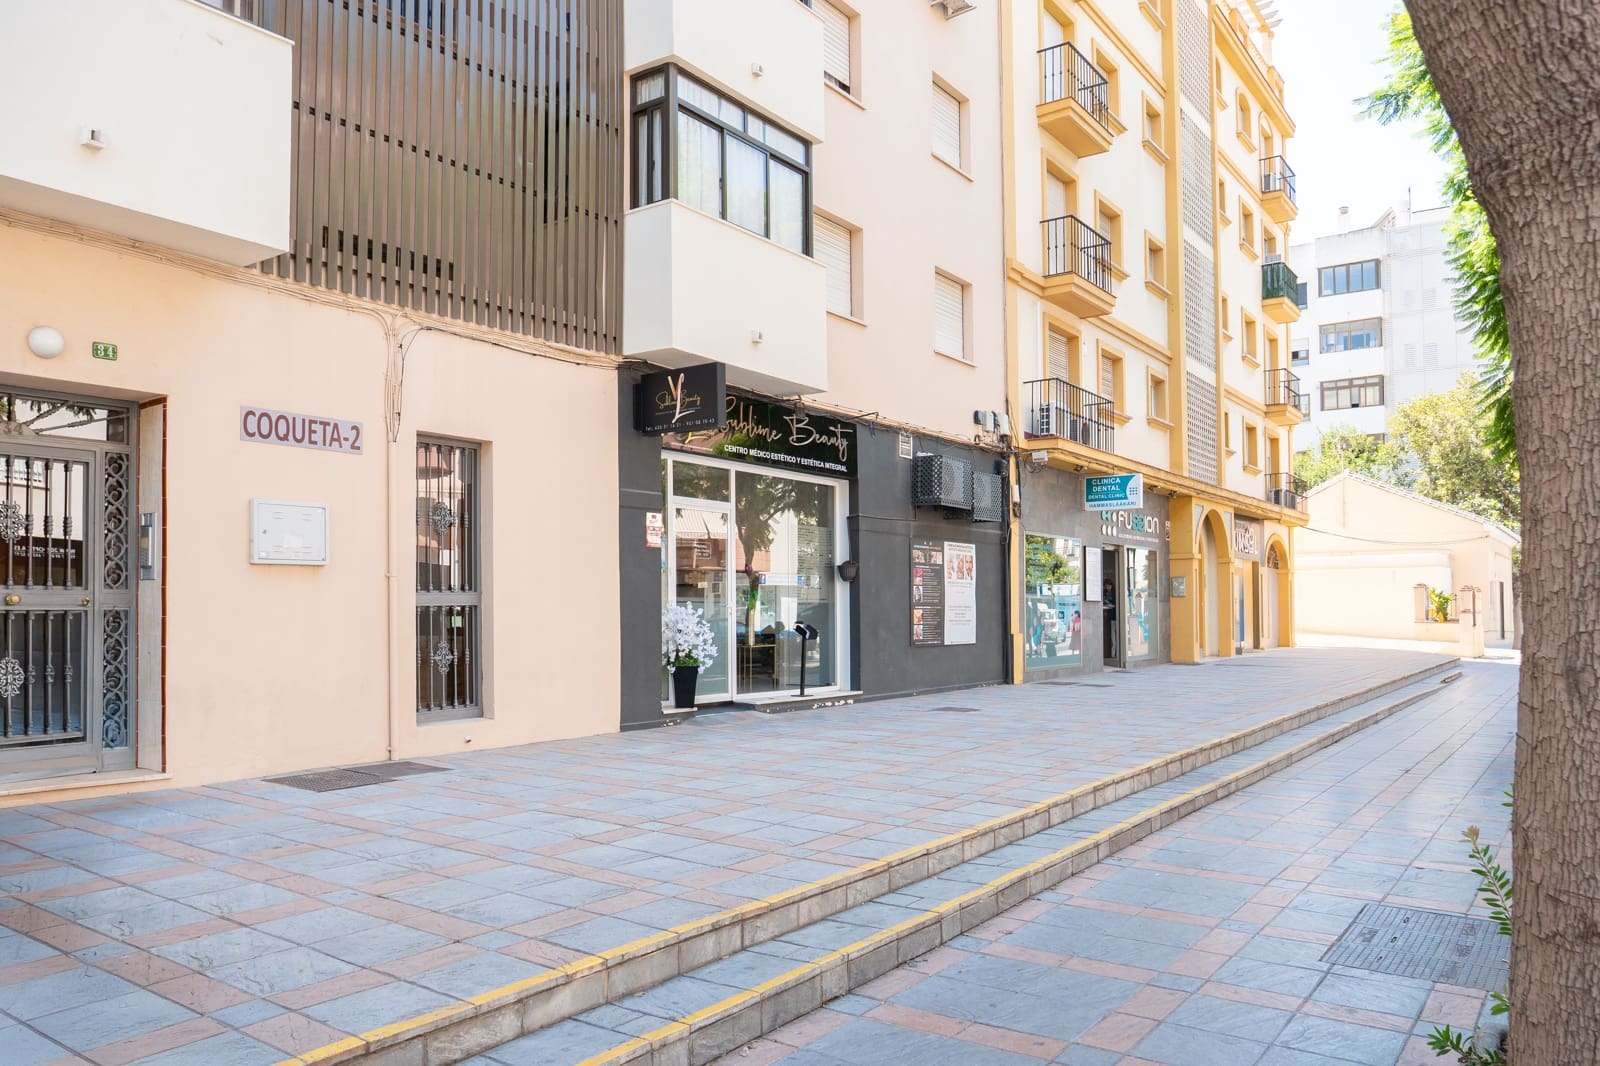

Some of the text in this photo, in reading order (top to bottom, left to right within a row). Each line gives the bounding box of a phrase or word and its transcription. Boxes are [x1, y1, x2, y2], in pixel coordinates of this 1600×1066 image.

[242, 409, 361, 451] COQUETA-2
[720, 396, 854, 462] Sublime Beauty
[724, 444, 848, 472] CENTRO MÉDICO ESTÉTICO Y ESTÉTICA INTEGRAL
[1092, 485, 1121, 493] DENTAL
